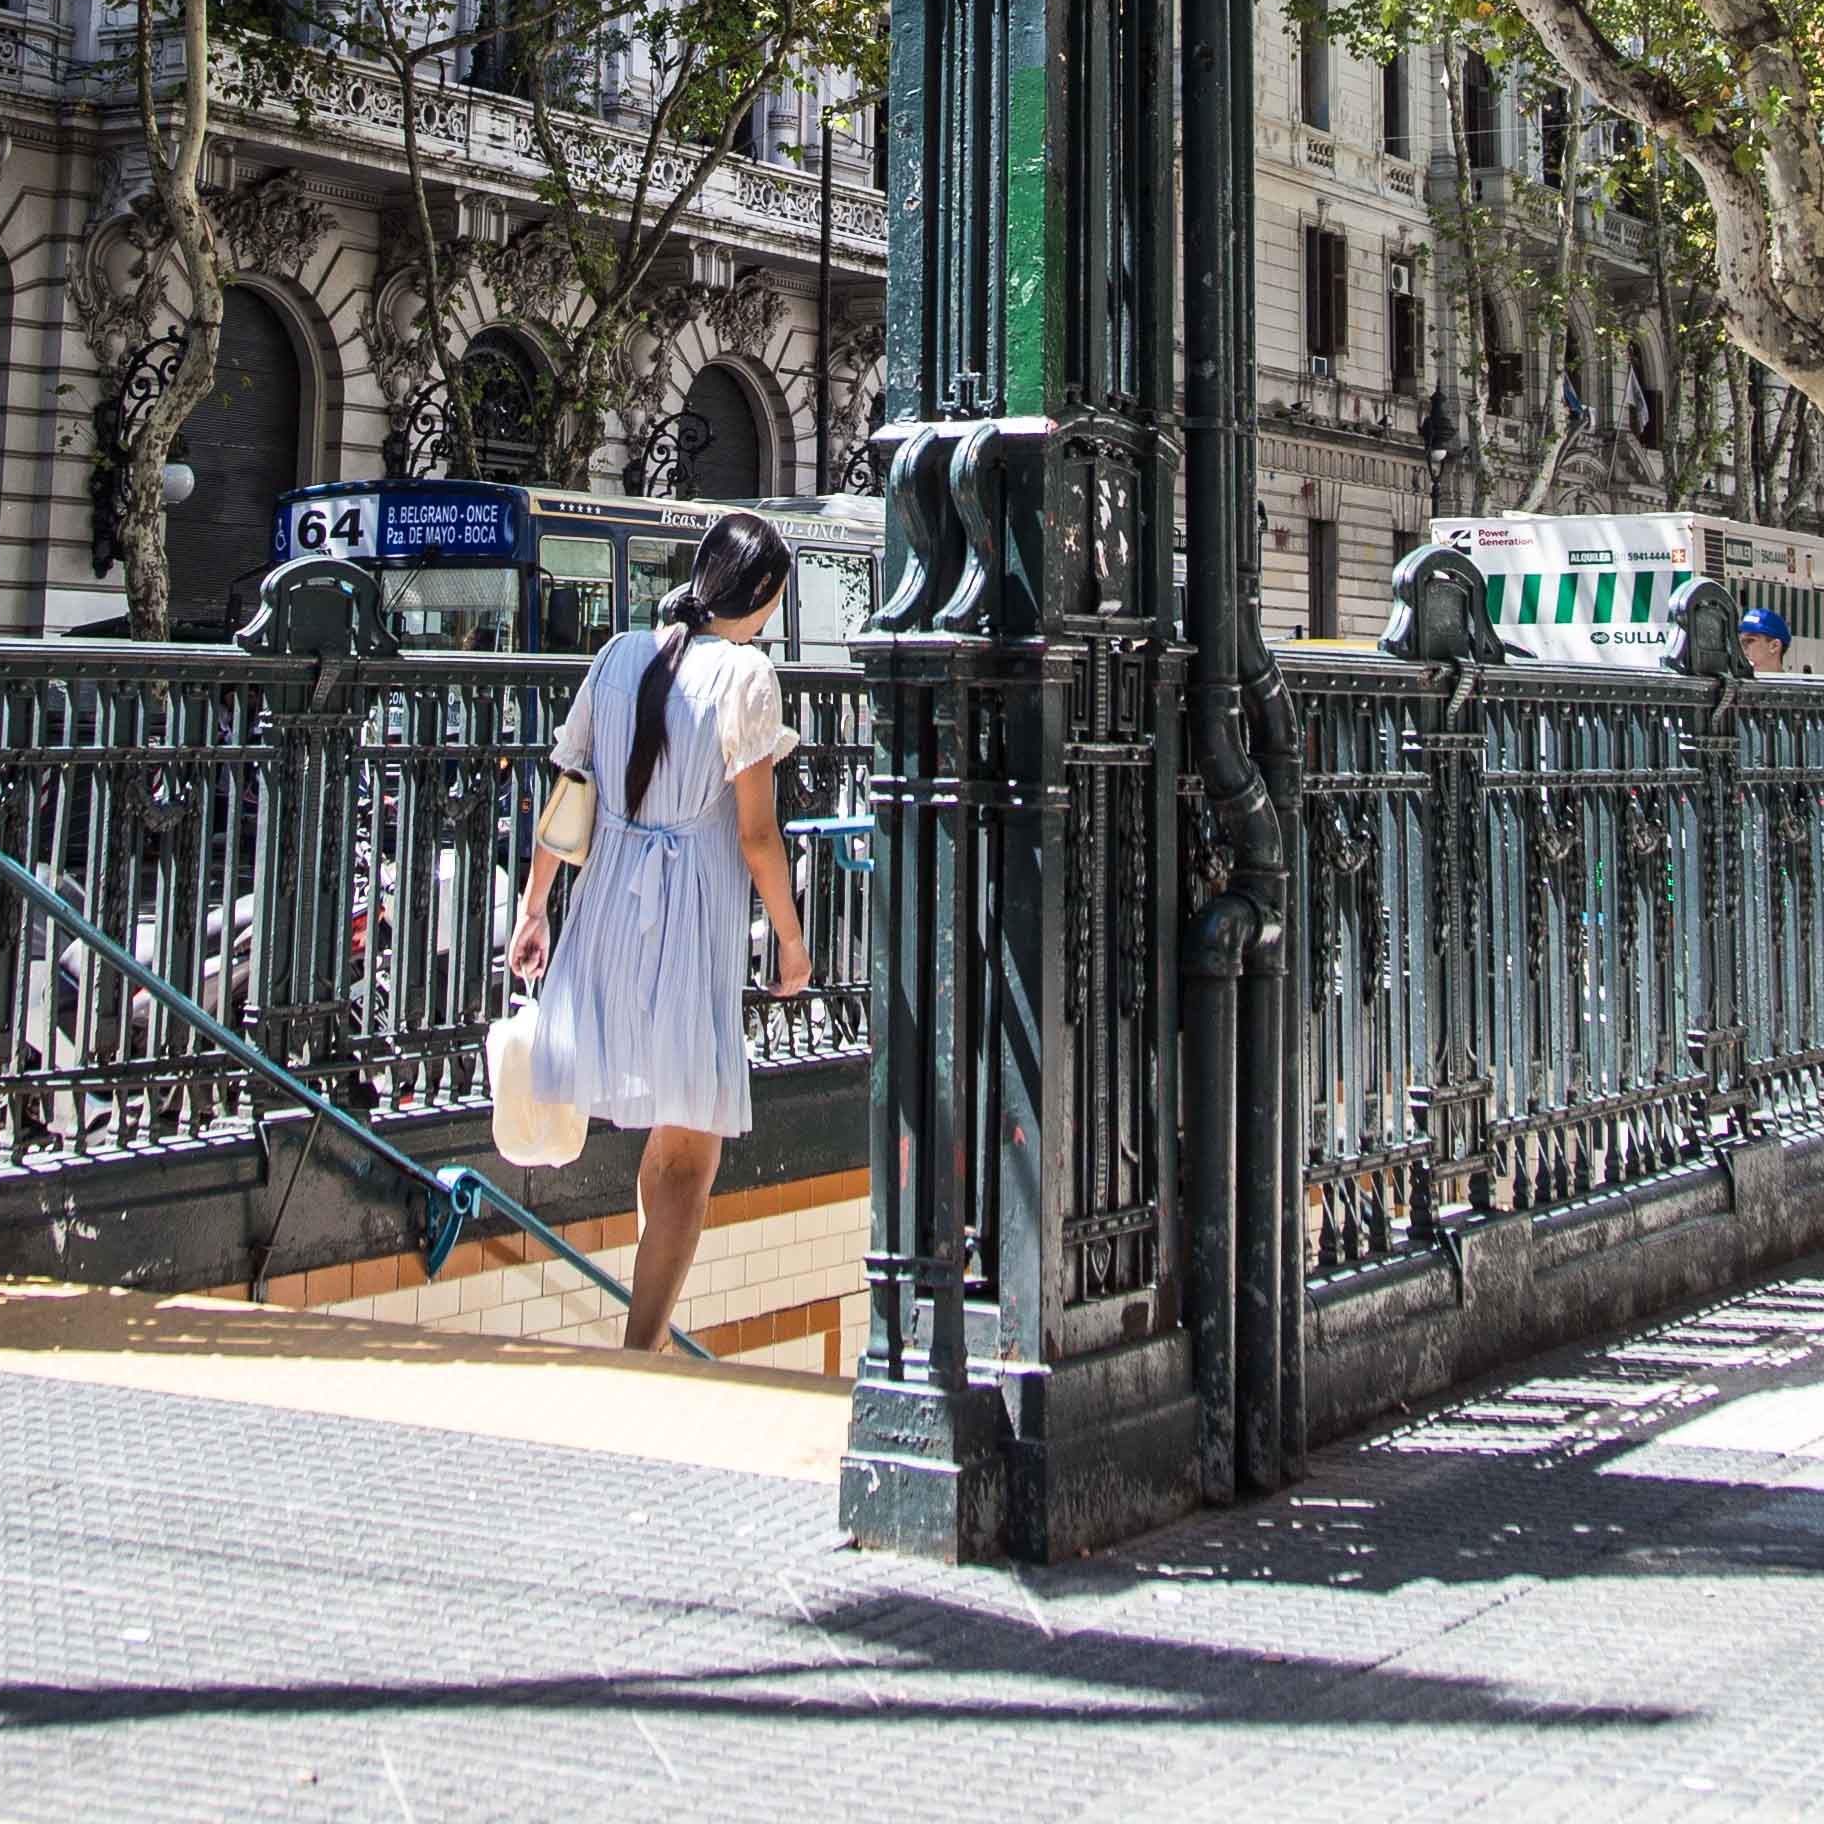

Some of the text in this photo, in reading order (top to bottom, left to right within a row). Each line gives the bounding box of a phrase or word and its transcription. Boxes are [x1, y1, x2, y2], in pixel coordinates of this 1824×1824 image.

[388, 506, 398, 524] B.
[400, 504, 458, 524] BELGRANO
[467, 504, 498, 523] ONCE
[297, 508, 364, 551] 64
[386, 526, 407, 545] Pza.
[409, 526, 424, 545] DE
[426, 526, 457, 545] MAYO
[464, 525, 497, 544] BOCA
[1478, 529, 1510, 537] Power
[1478, 538, 1534, 546] Generation
[1570, 551, 1612, 563] ALQUILER
[1613, 631, 1669, 644] SULLA
